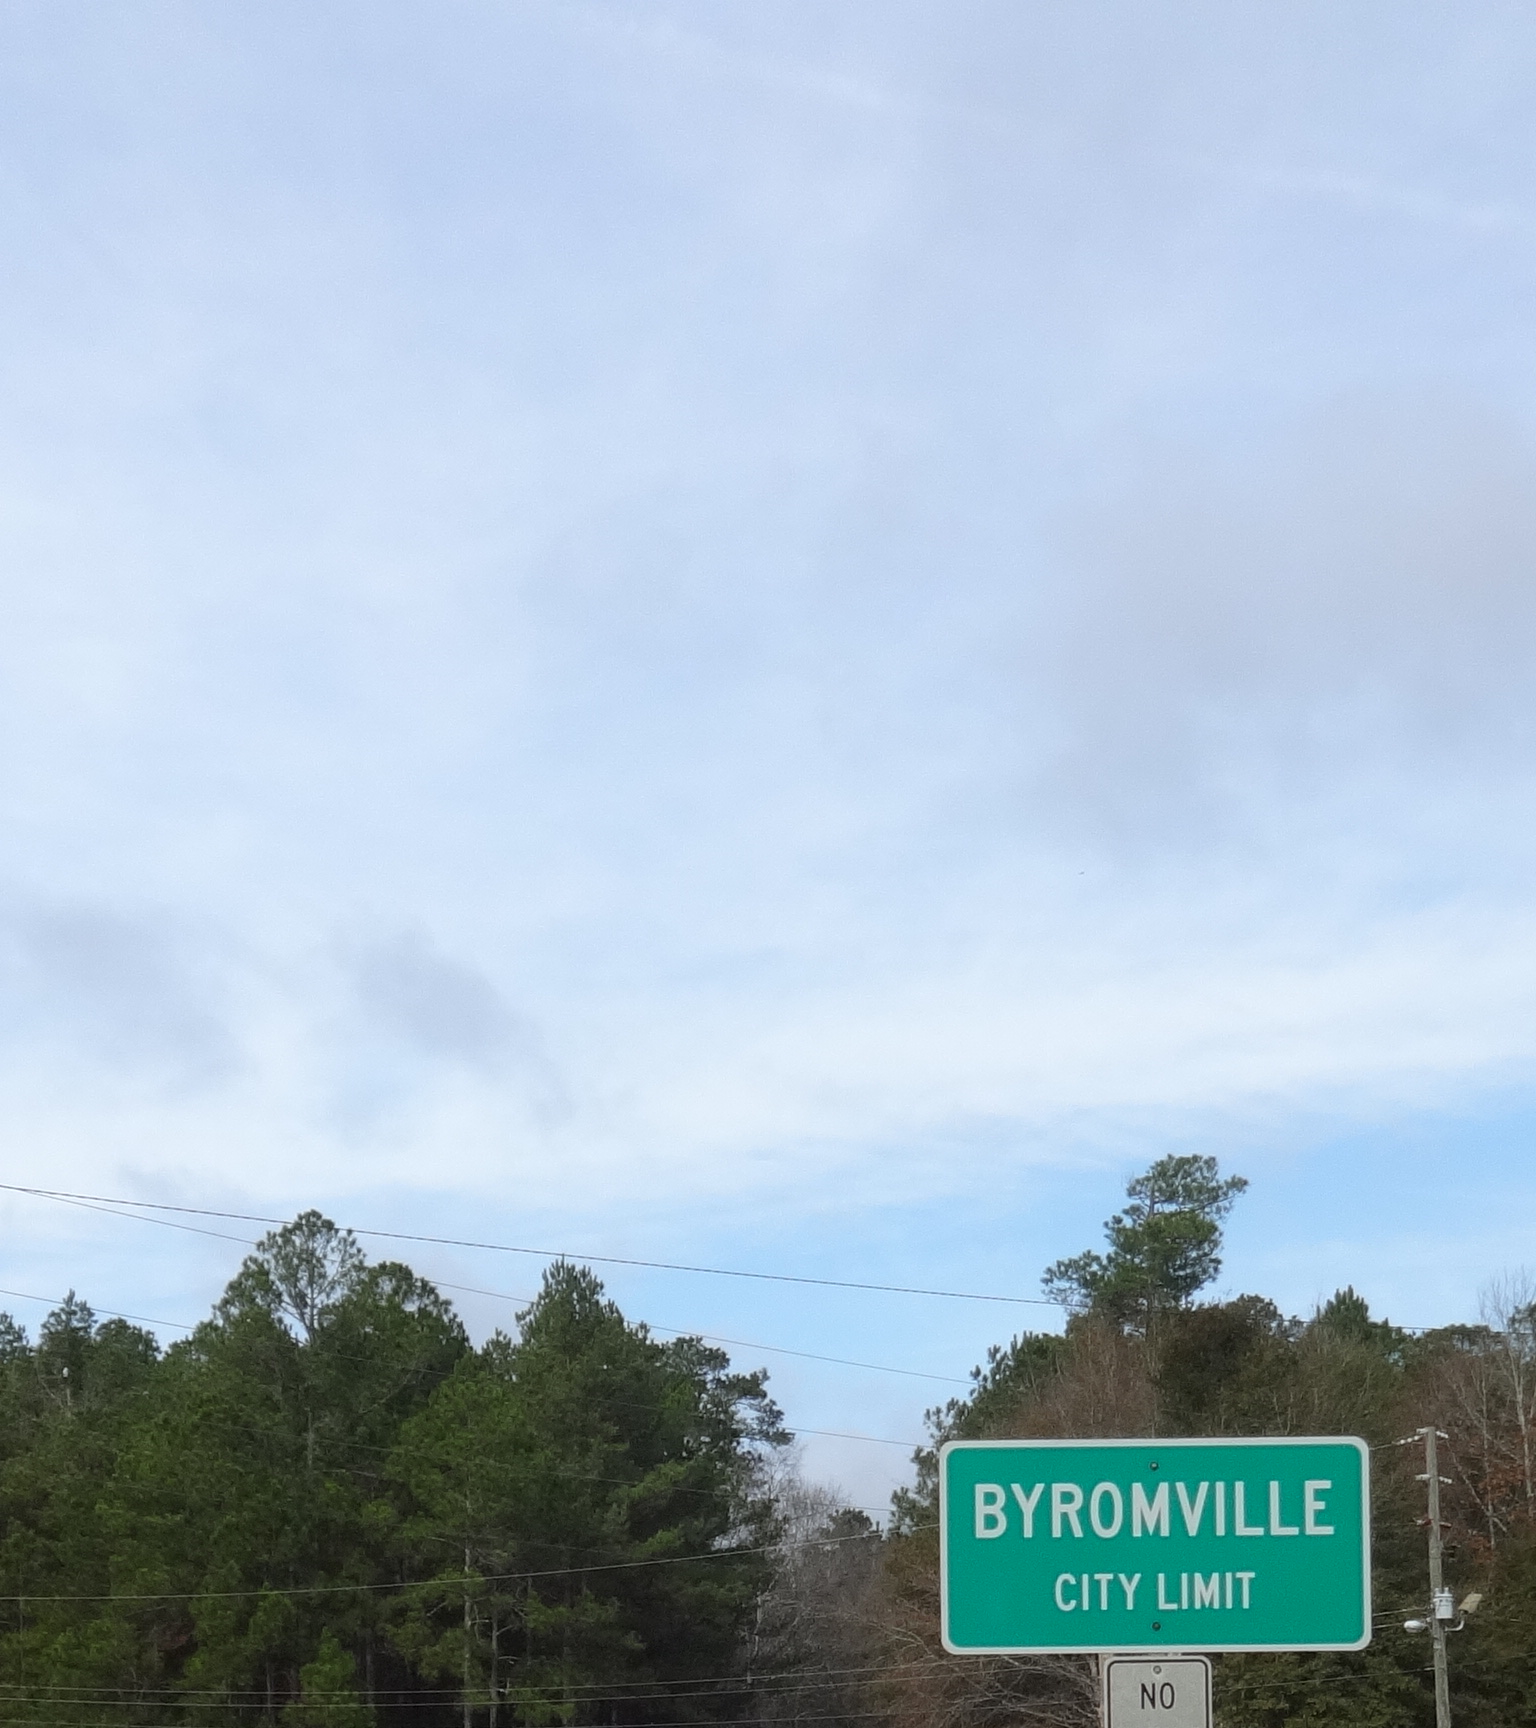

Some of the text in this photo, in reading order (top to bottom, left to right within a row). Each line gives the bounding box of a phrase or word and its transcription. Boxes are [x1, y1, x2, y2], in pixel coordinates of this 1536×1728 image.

[974, 1480, 1335, 1538] BYROMVILLE
[1055, 1571, 1256, 1611] CITY LIMIT
[1141, 1682, 1175, 1709] NO
